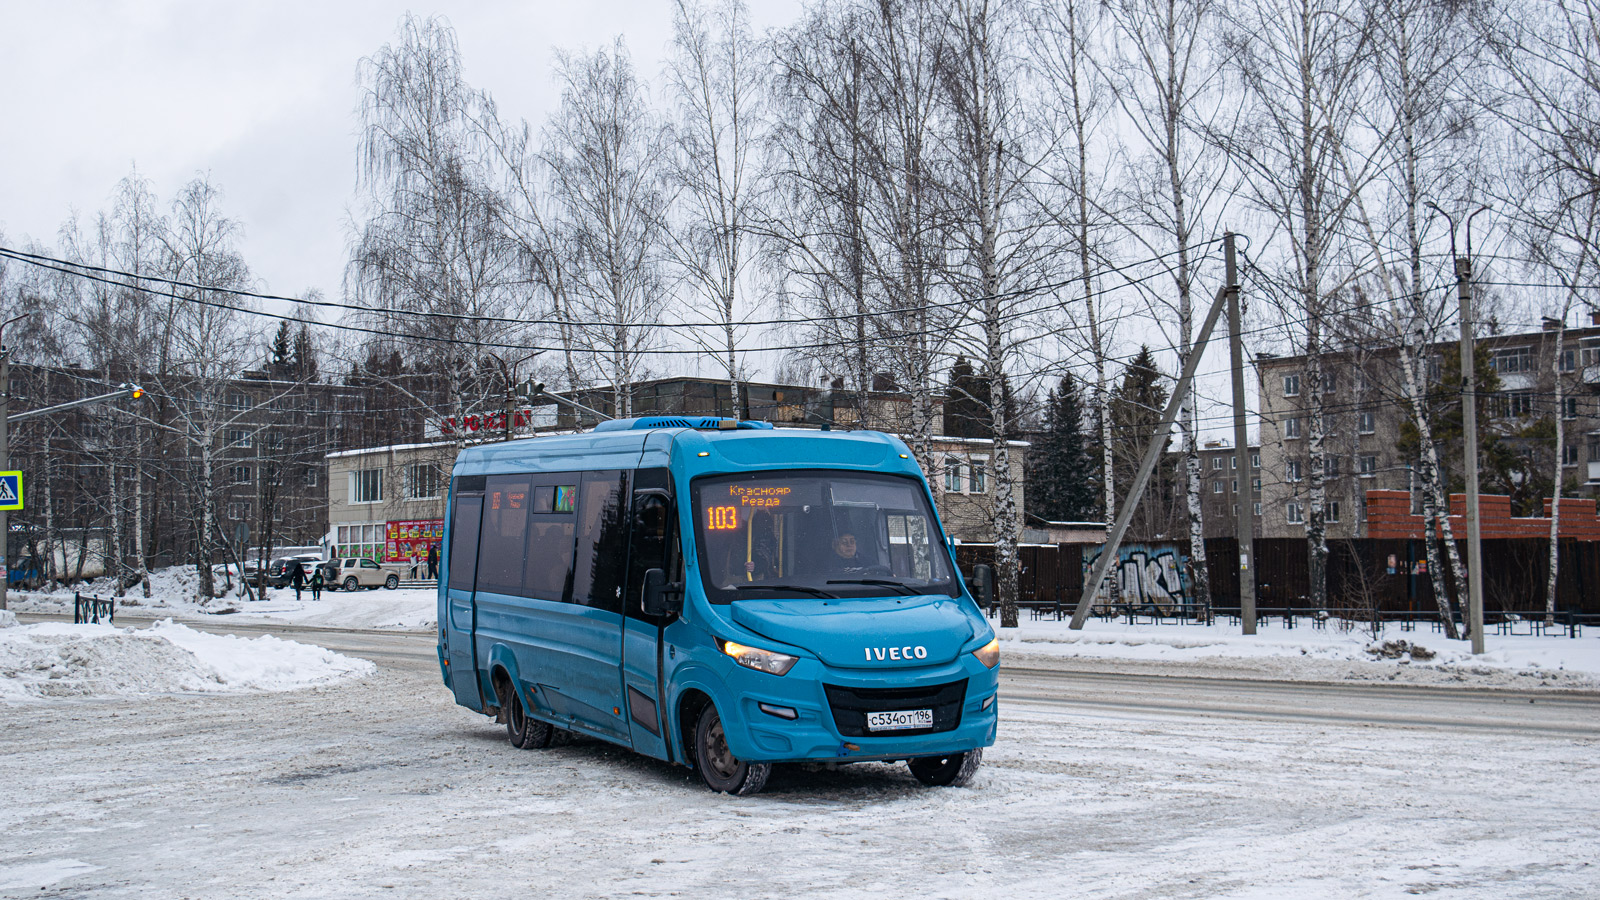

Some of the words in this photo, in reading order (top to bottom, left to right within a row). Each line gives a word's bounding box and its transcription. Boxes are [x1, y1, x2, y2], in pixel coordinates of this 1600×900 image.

[729, 485, 791, 496] Краснояр
[741, 495, 780, 507] Ревда
[707, 506, 737, 529] 103
[864, 645, 928, 661] IVECO
[914, 710, 930, 720] 196
